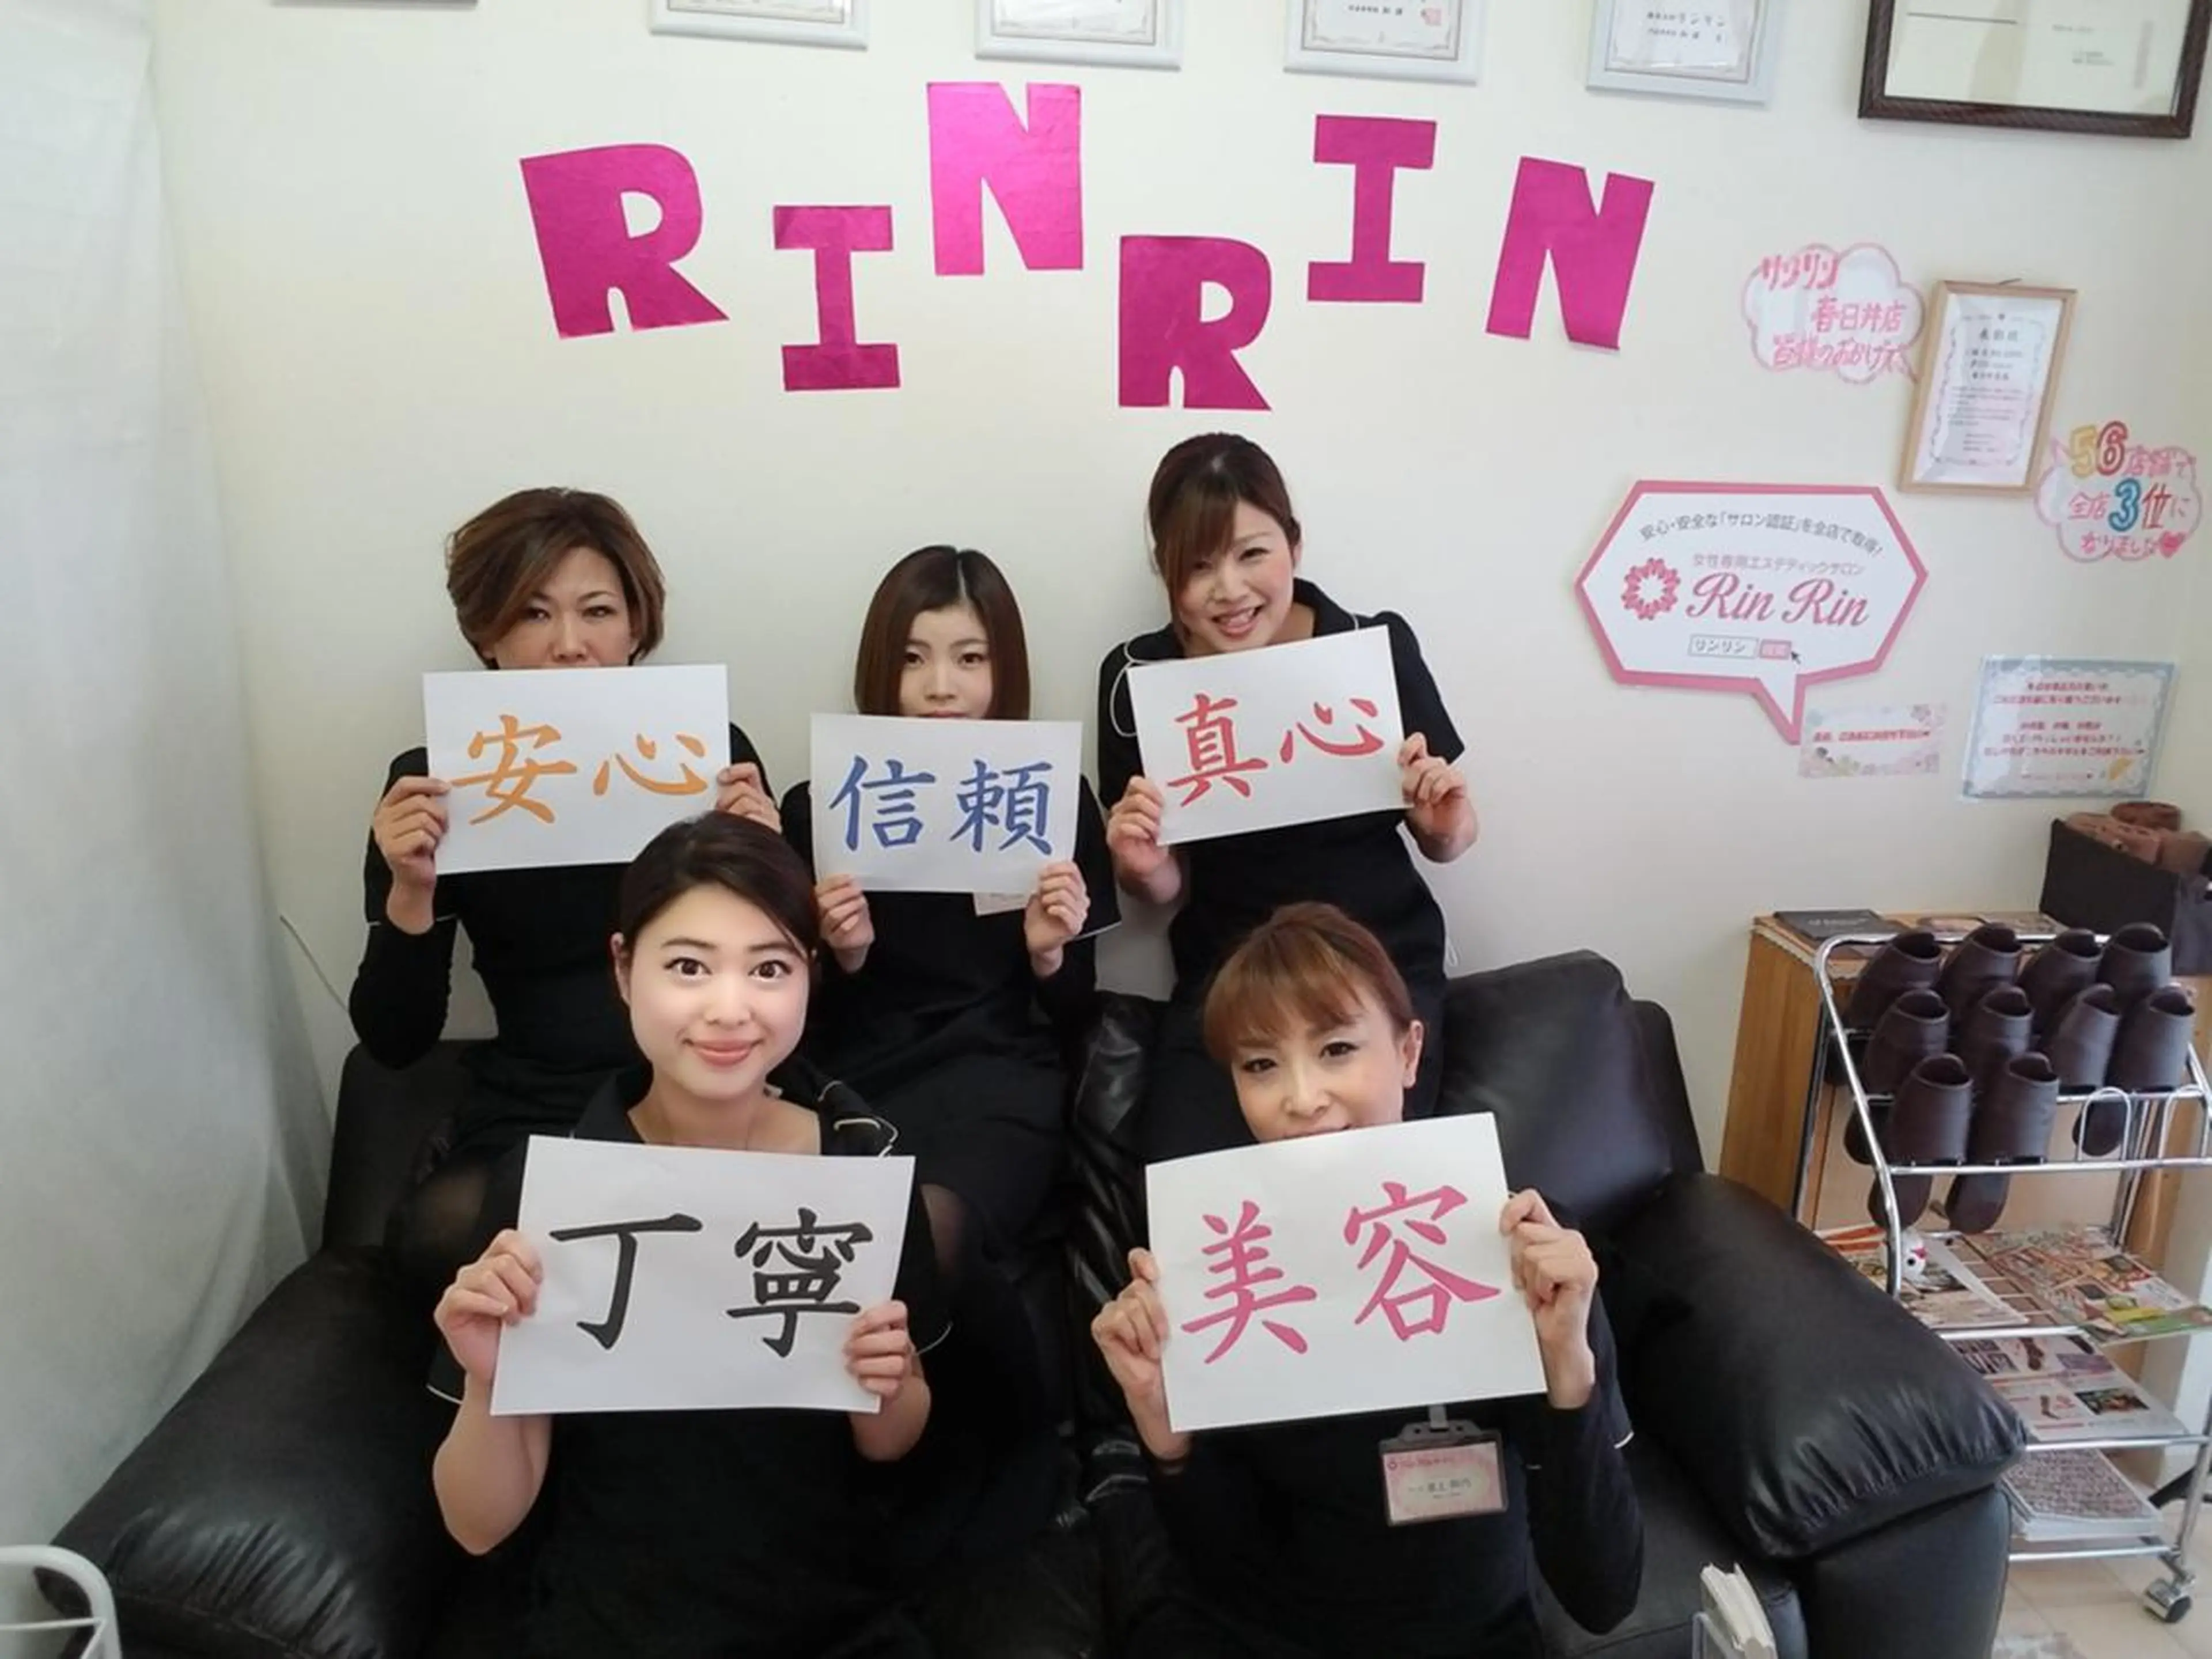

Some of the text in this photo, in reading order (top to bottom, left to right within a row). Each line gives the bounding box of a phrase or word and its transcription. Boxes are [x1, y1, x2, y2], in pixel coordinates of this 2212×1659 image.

[1812, 295, 1907, 333] 春日井店
[1685, 572, 1870, 627] Rin Rin
[453, 714, 709, 825] 安心
[1166, 692, 1384, 806] 真心
[830, 755, 1054, 855] 信頼
[549, 1207, 873, 1359] 丁寧
[1181, 1181, 1502, 1365] 美容
